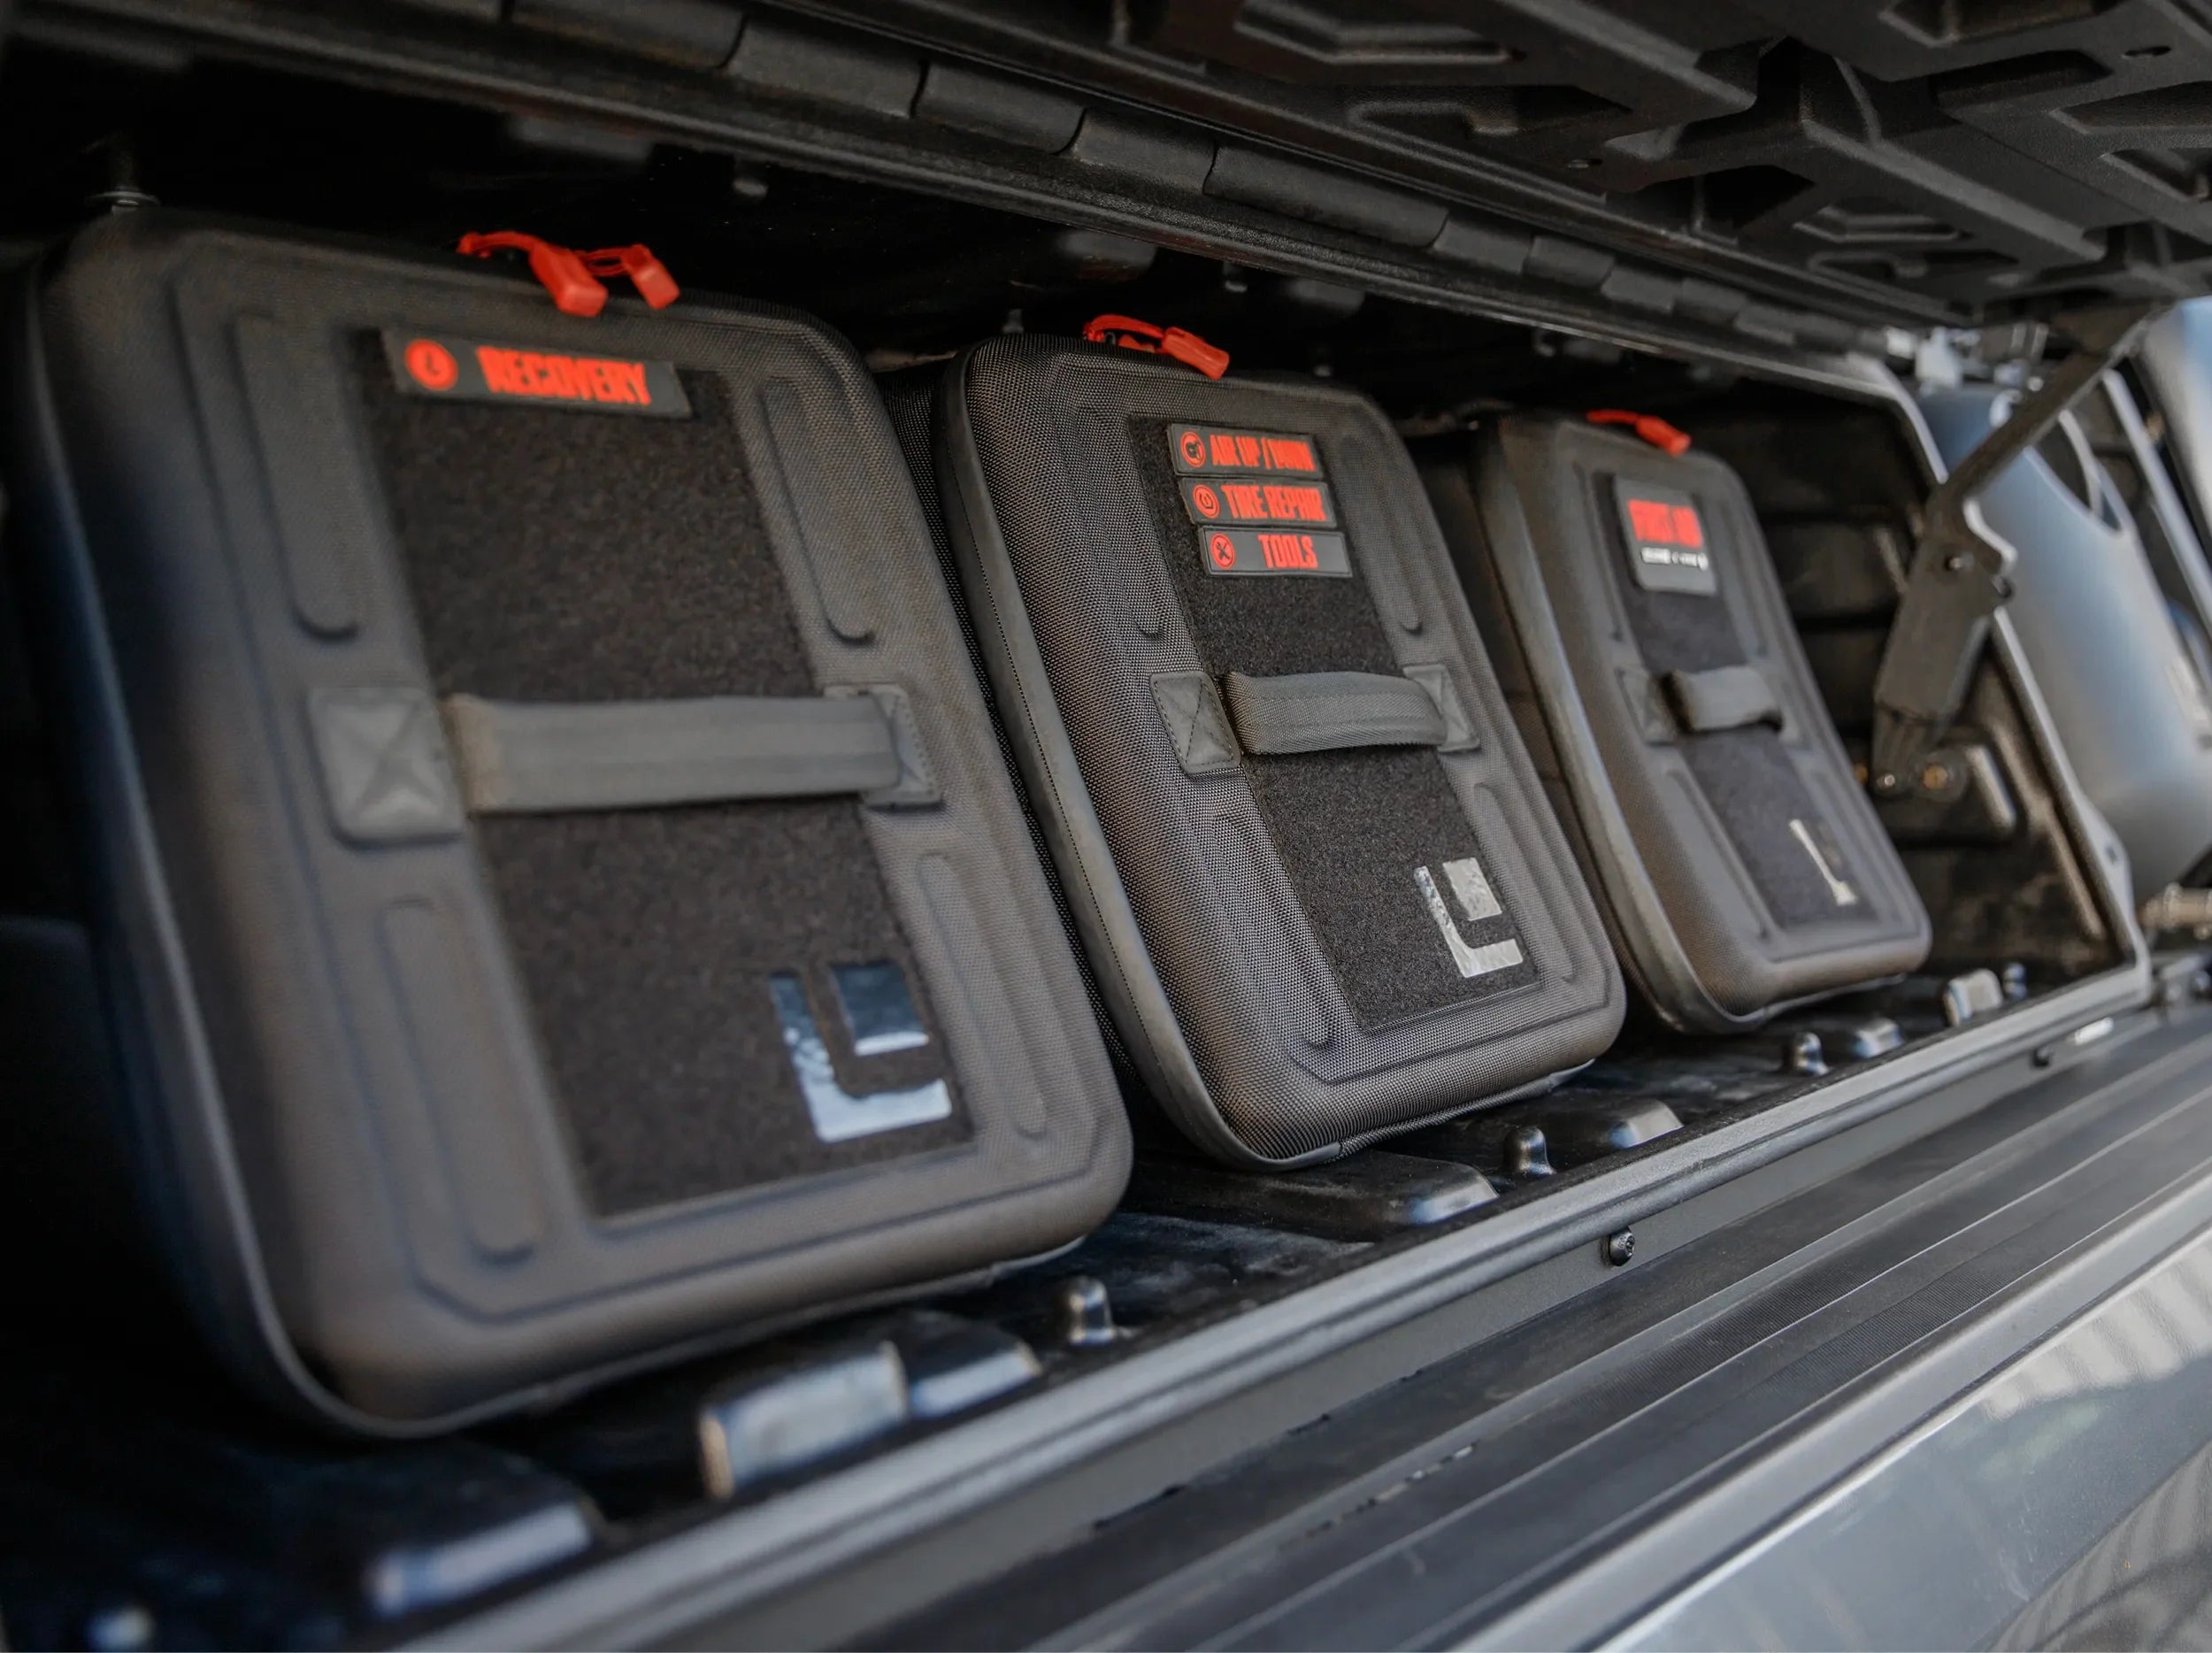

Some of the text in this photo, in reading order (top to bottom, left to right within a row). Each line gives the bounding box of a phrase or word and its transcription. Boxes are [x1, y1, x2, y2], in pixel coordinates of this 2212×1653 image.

[475, 347, 652, 407] RECOVERY
[1210, 434, 1241, 466] AIR
[1235, 436, 1261, 468] UP
[1261, 437, 1271, 471] /
[1220, 485, 1327, 520] TIRE REPAIR
[1256, 534, 1318, 569] TOOLS
